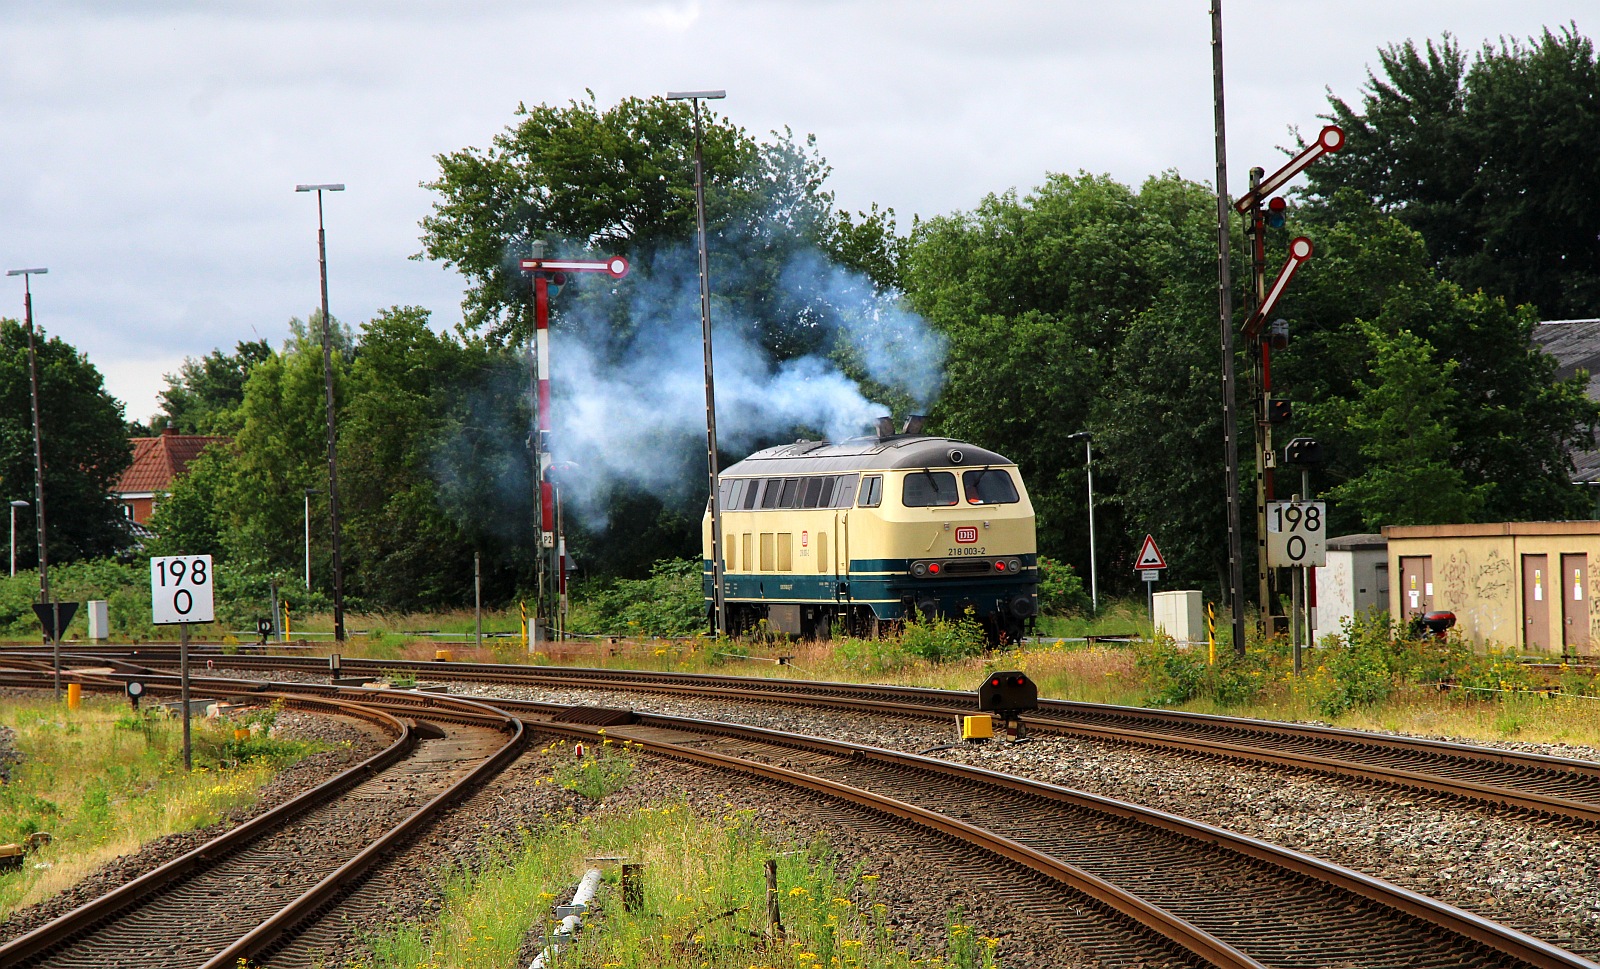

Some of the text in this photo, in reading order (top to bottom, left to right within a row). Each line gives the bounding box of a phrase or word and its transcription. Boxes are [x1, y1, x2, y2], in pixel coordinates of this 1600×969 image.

[1274, 506, 1320, 532] 198
[964, 547, 986, 555] 003-2
[1287, 535, 1306, 561] 0
[157, 560, 206, 586] 198
[174, 589, 192, 614] 0
